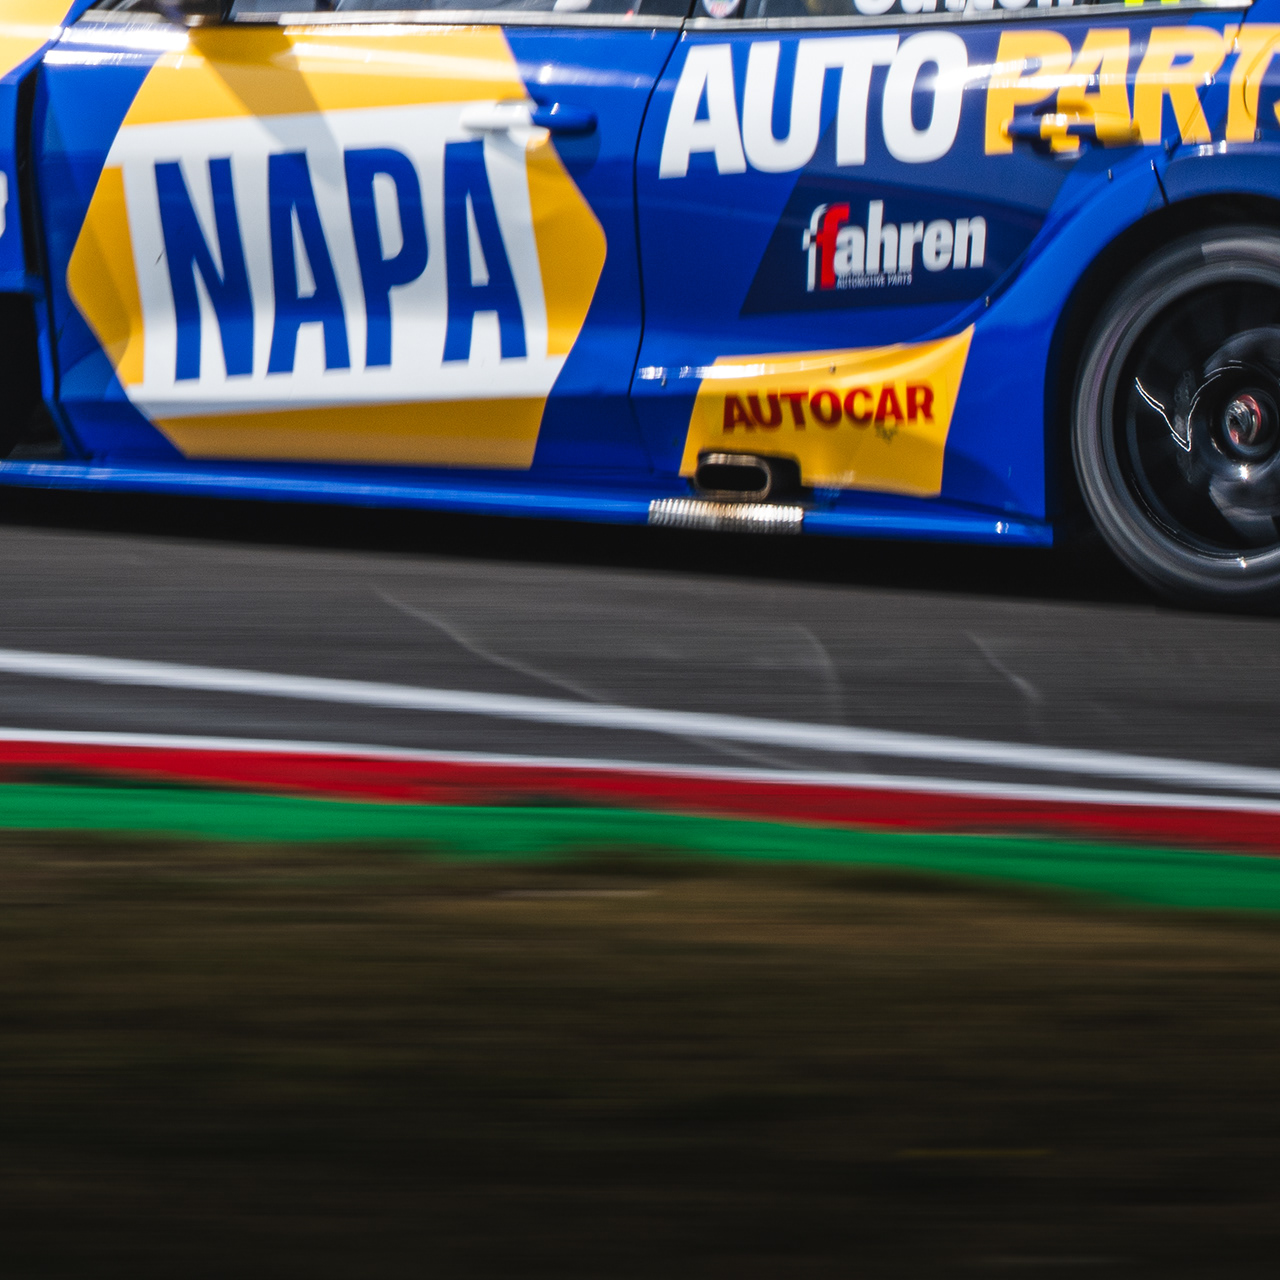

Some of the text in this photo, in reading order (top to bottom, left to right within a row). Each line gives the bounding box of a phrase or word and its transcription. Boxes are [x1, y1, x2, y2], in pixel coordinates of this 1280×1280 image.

[658, 30, 969, 180] AUTO
[153, 137, 530, 385] NAPA
[802, 199, 987, 293] fahren
[723, 381, 936, 434] AUTOCAR
